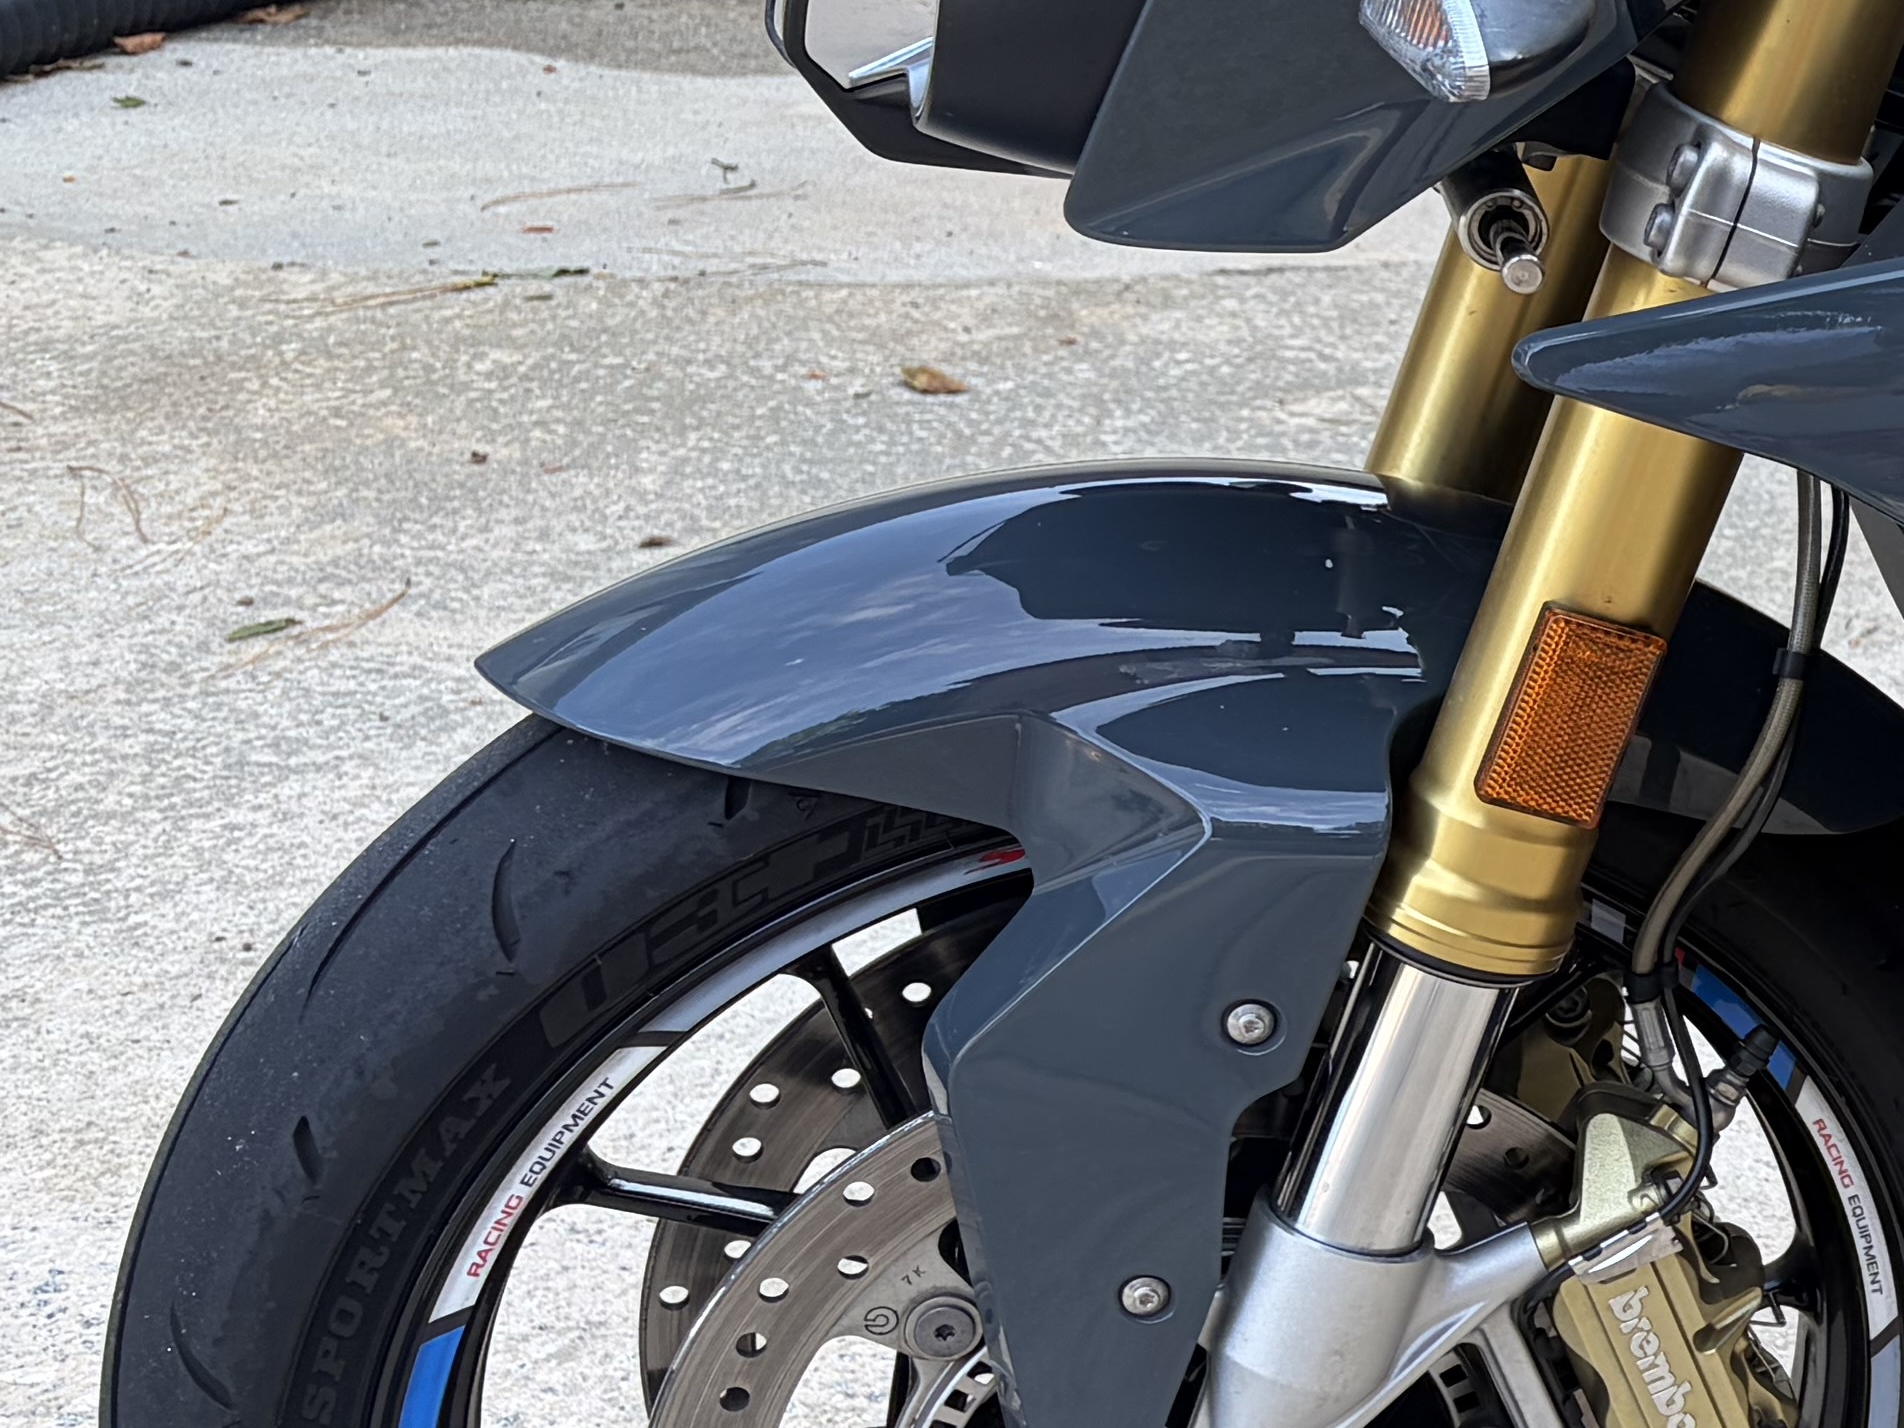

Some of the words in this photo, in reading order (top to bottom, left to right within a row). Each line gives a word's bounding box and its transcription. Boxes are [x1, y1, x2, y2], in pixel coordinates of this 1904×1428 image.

[302, 1062, 512, 1426] SPORTMAX
[465, 1189, 524, 1280] RACING
[520, 1075, 616, 1191] EQUIPMENT
[1812, 1118, 1856, 1190] RACING
[1846, 1192, 1885, 1296] EQUIPMENT
